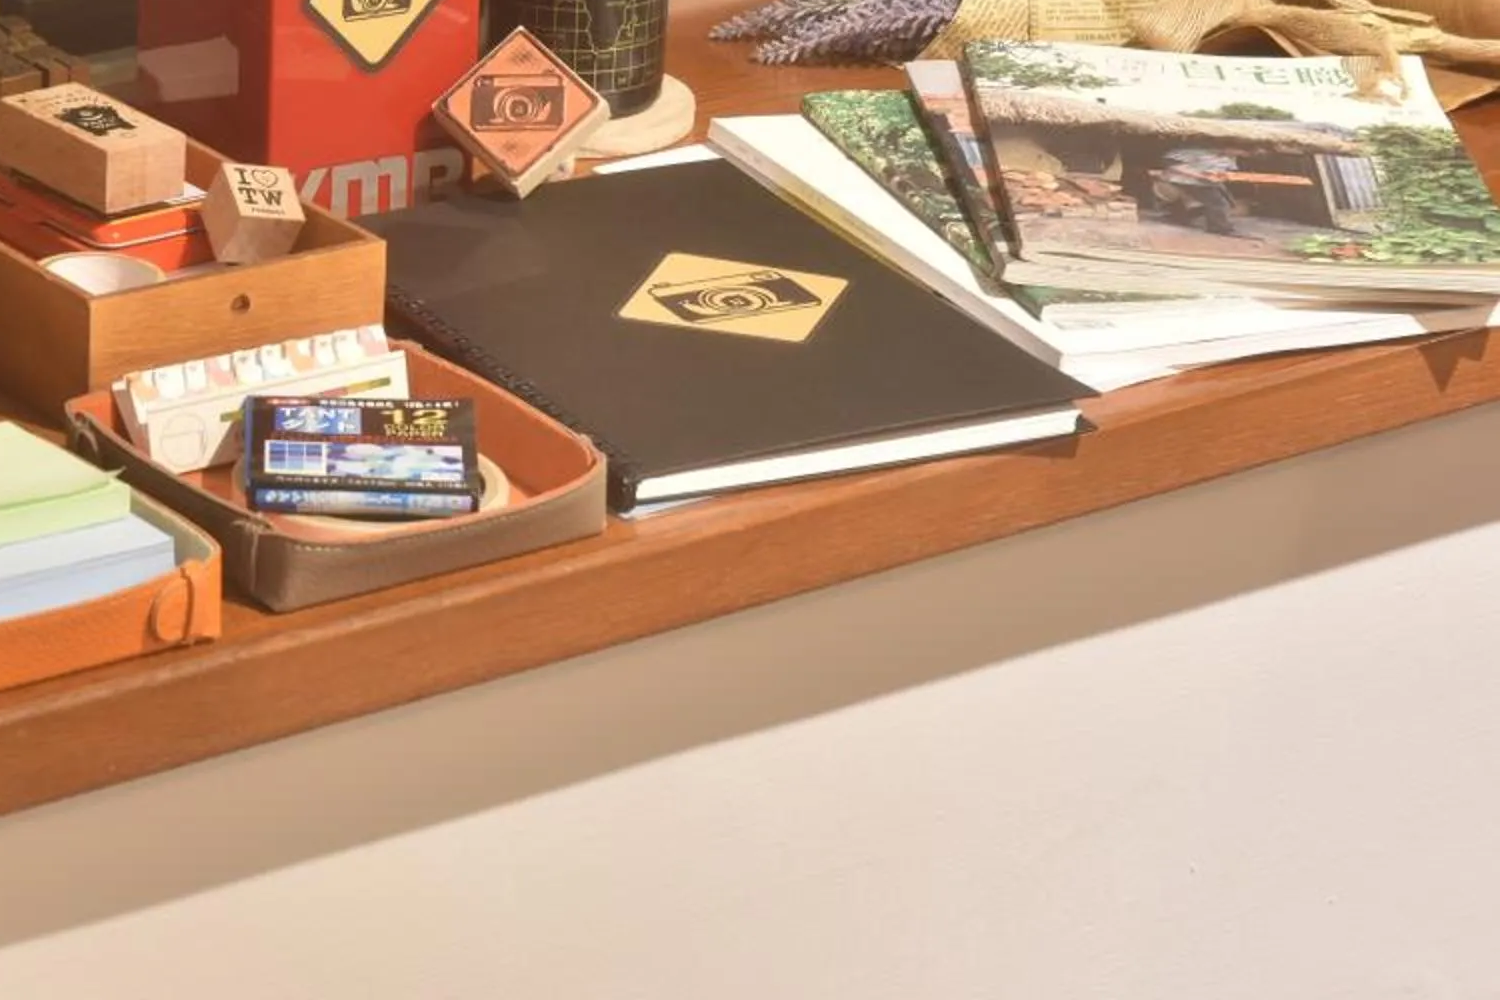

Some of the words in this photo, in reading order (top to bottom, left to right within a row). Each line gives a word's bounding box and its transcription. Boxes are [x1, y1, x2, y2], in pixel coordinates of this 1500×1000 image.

[234, 168, 251, 185] I
[238, 187, 283, 206] TW
[381, 408, 449, 424] 12
